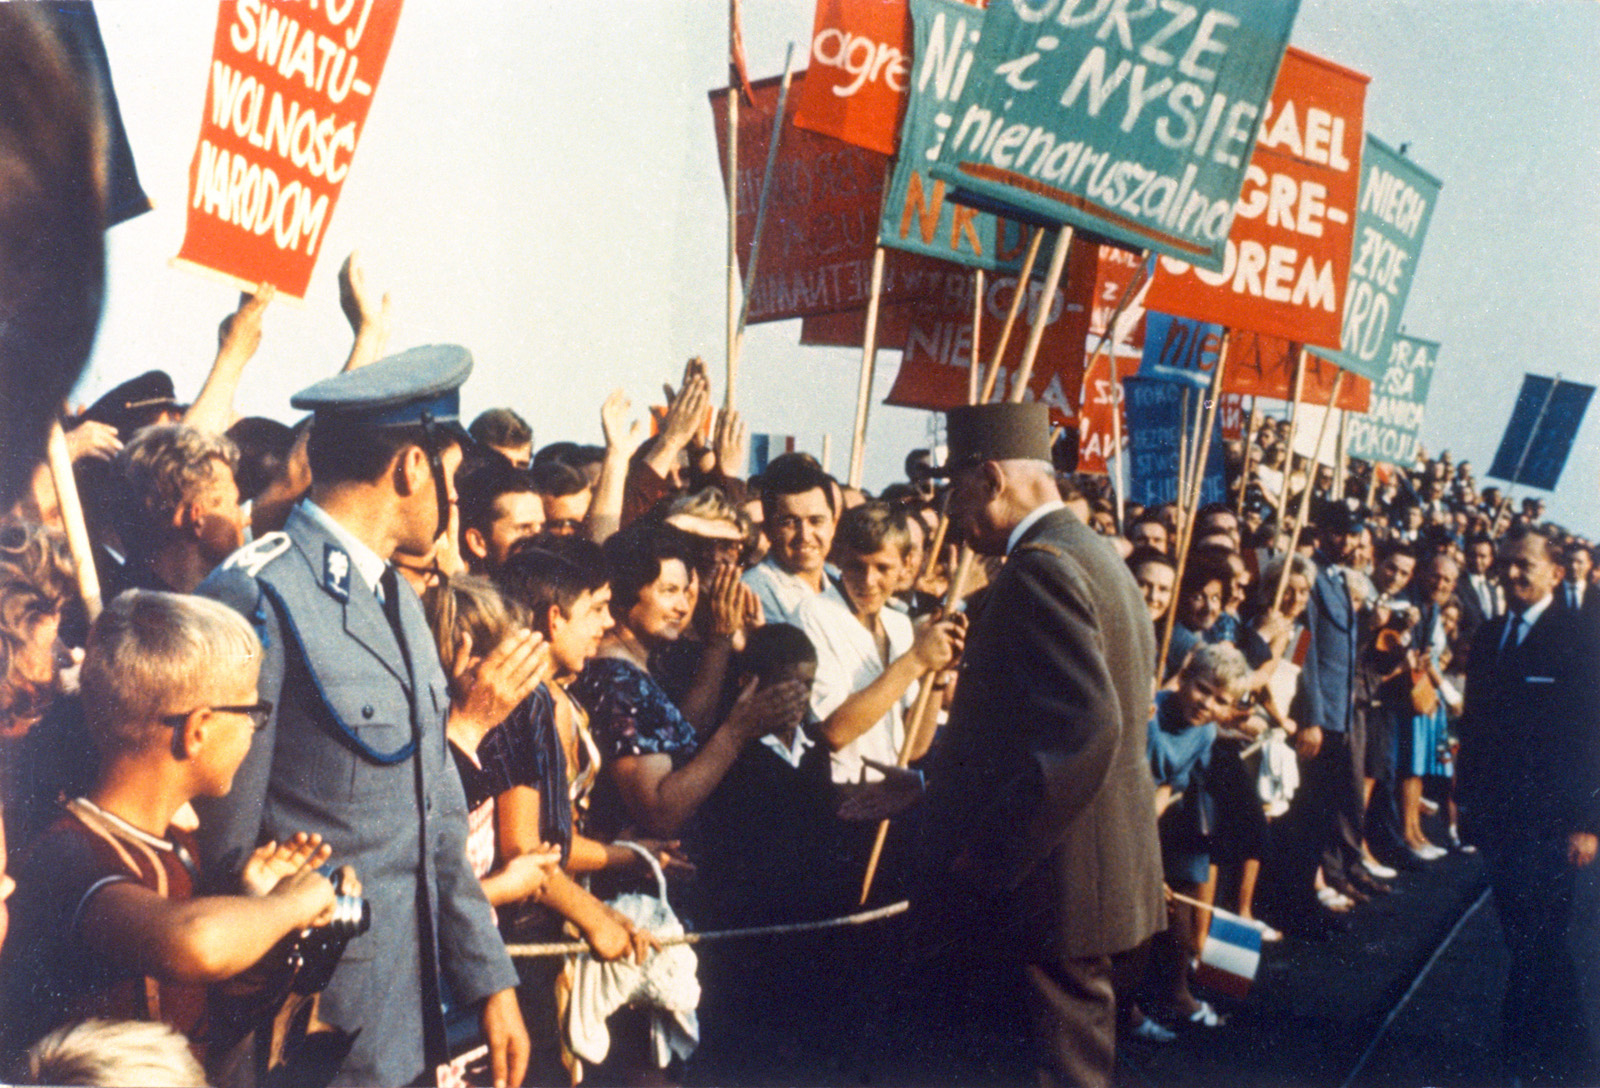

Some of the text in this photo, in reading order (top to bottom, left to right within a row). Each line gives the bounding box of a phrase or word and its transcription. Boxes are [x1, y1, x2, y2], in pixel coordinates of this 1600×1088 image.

[1059, 46, 1259, 169] NYSIE
[193, 140, 329, 256] NARODOM
[952, 99, 1234, 241] nienaruszalna
[1161, 238, 1337, 313] OREM
